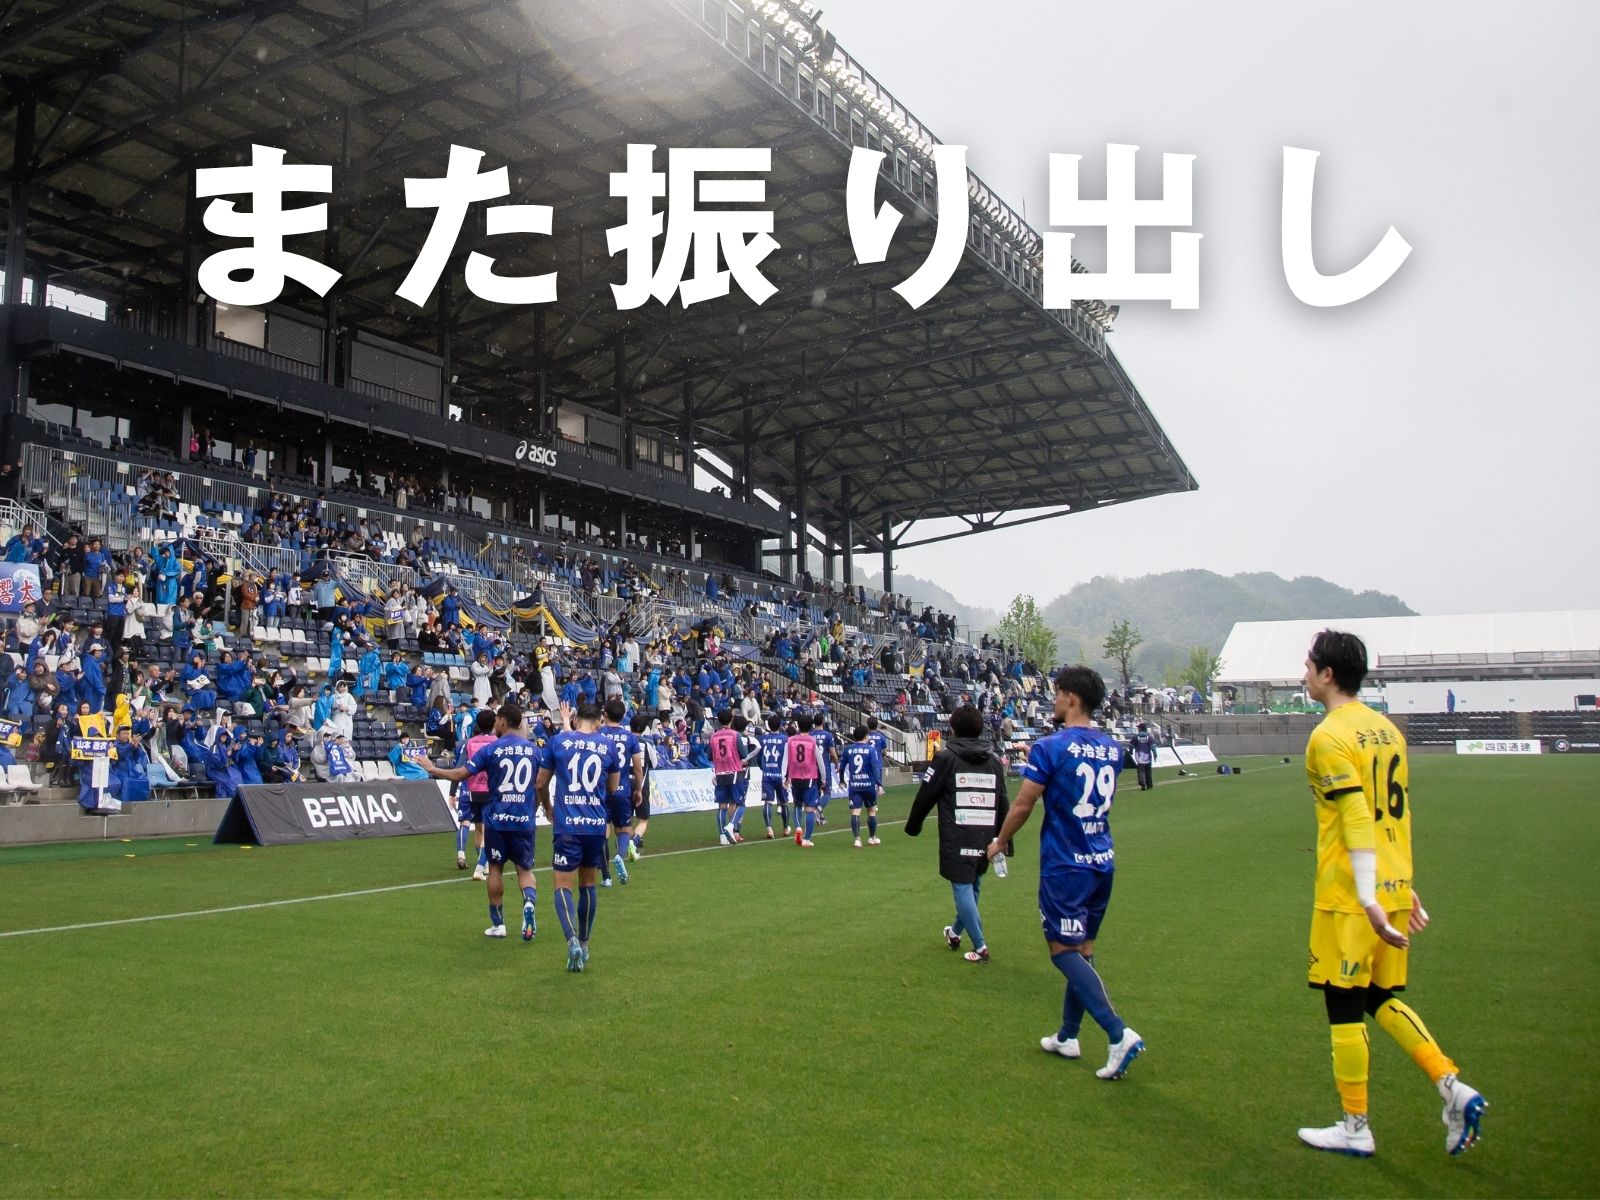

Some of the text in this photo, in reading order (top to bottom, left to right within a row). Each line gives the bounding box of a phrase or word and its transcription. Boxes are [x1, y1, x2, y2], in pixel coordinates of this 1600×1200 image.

[528, 445, 557, 467] asics
[494, 746, 533, 757] 今治造船
[562, 739, 608, 754] 今治造船
[719, 739, 727, 757] 5
[763, 745, 780, 762] 44
[796, 744, 805, 763] 8
[1067, 742, 1118, 761] 今治造船
[1485, 743, 1531, 751] 四国通建
[567, 752, 602, 792] 10
[853, 754, 863, 773] 9
[498, 757, 532, 793] 20
[501, 794, 525, 803] RODRIGO
[1072, 762, 1115, 819] 29
[302, 793, 403, 828] BEMAC
